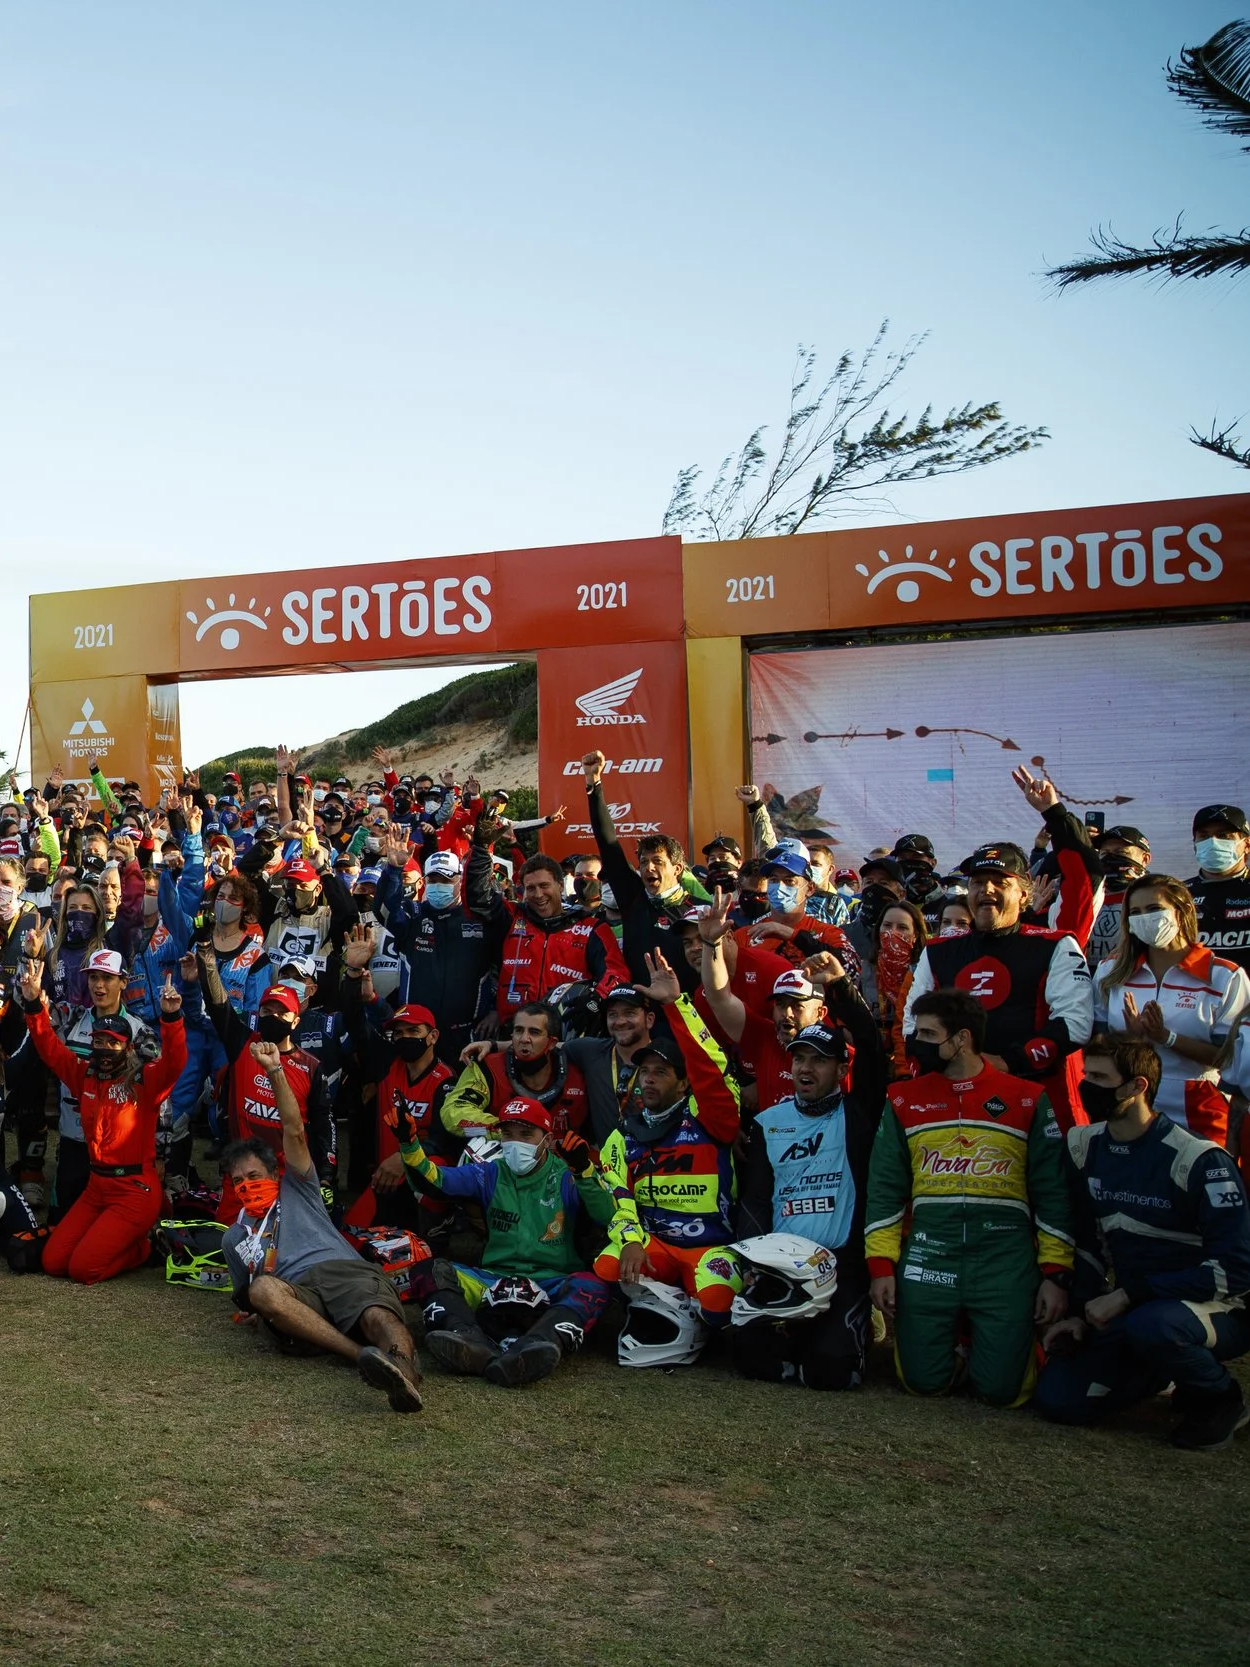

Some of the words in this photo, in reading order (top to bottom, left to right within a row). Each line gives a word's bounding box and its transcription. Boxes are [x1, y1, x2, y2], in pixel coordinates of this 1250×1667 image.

[577, 580, 628, 612] 2021
[725, 575, 776, 604] 2021
[73, 623, 115, 650] 2021
[576, 714, 647, 727] HONDA
[62, 737, 115, 749] MITSUBISHI
[550, 963, 584, 980] MOTUL
[817, 1260, 833, 1274] 08
[206, 1272, 222, 1282] 19
[922, 1271, 956, 1285] BRASIL
